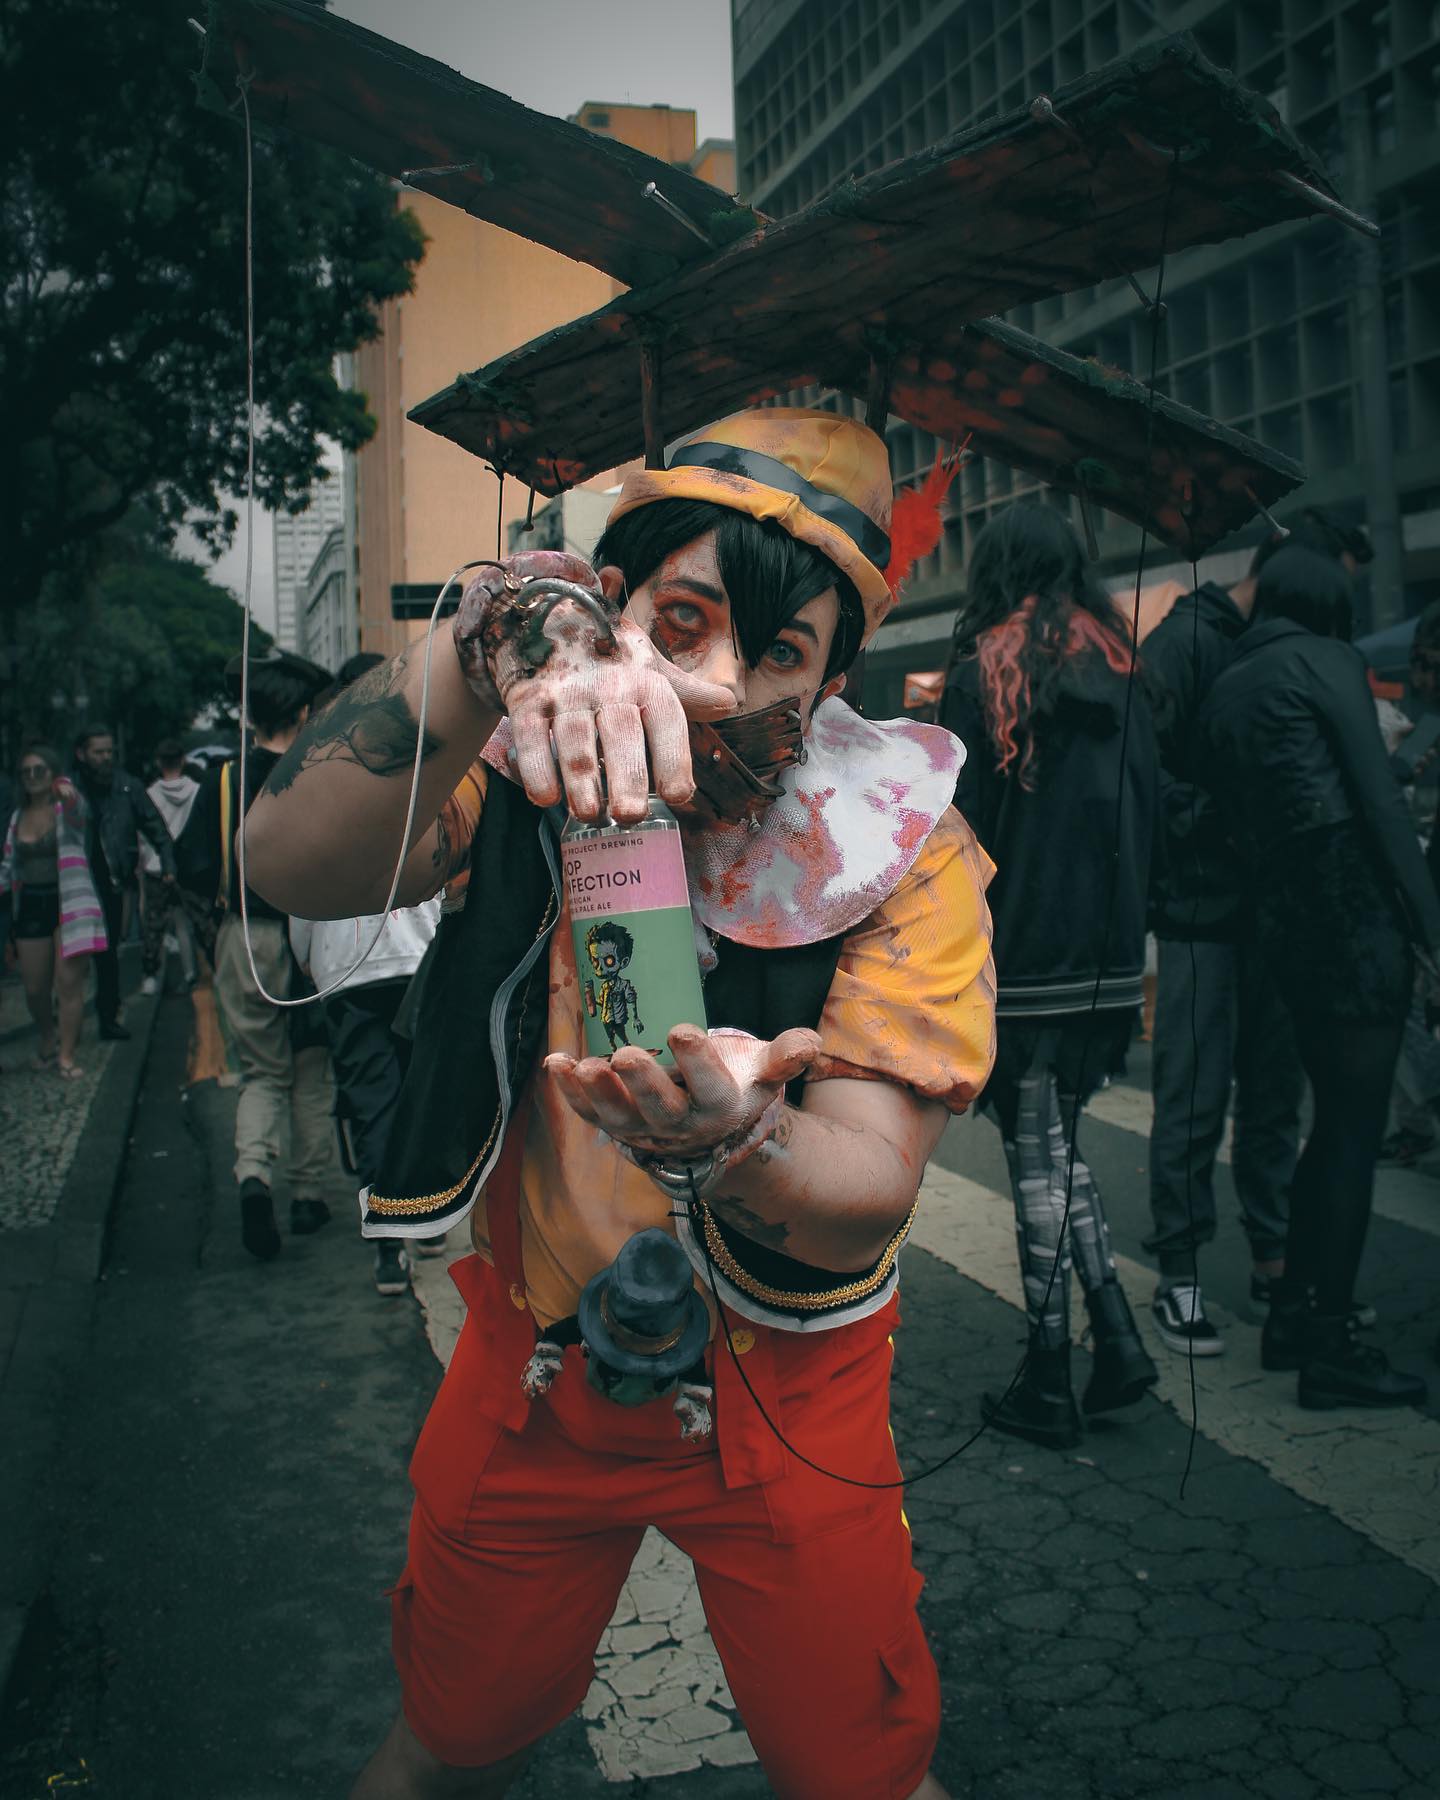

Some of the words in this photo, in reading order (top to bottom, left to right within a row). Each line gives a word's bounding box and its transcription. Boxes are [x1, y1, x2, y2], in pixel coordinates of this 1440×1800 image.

[568, 844, 598, 855] PROJECT
[601, 838, 644, 850] BREWING
[565, 860, 582, 876] OP
[569, 869, 642, 893] FECTION
[597, 902, 612, 911] ALE
